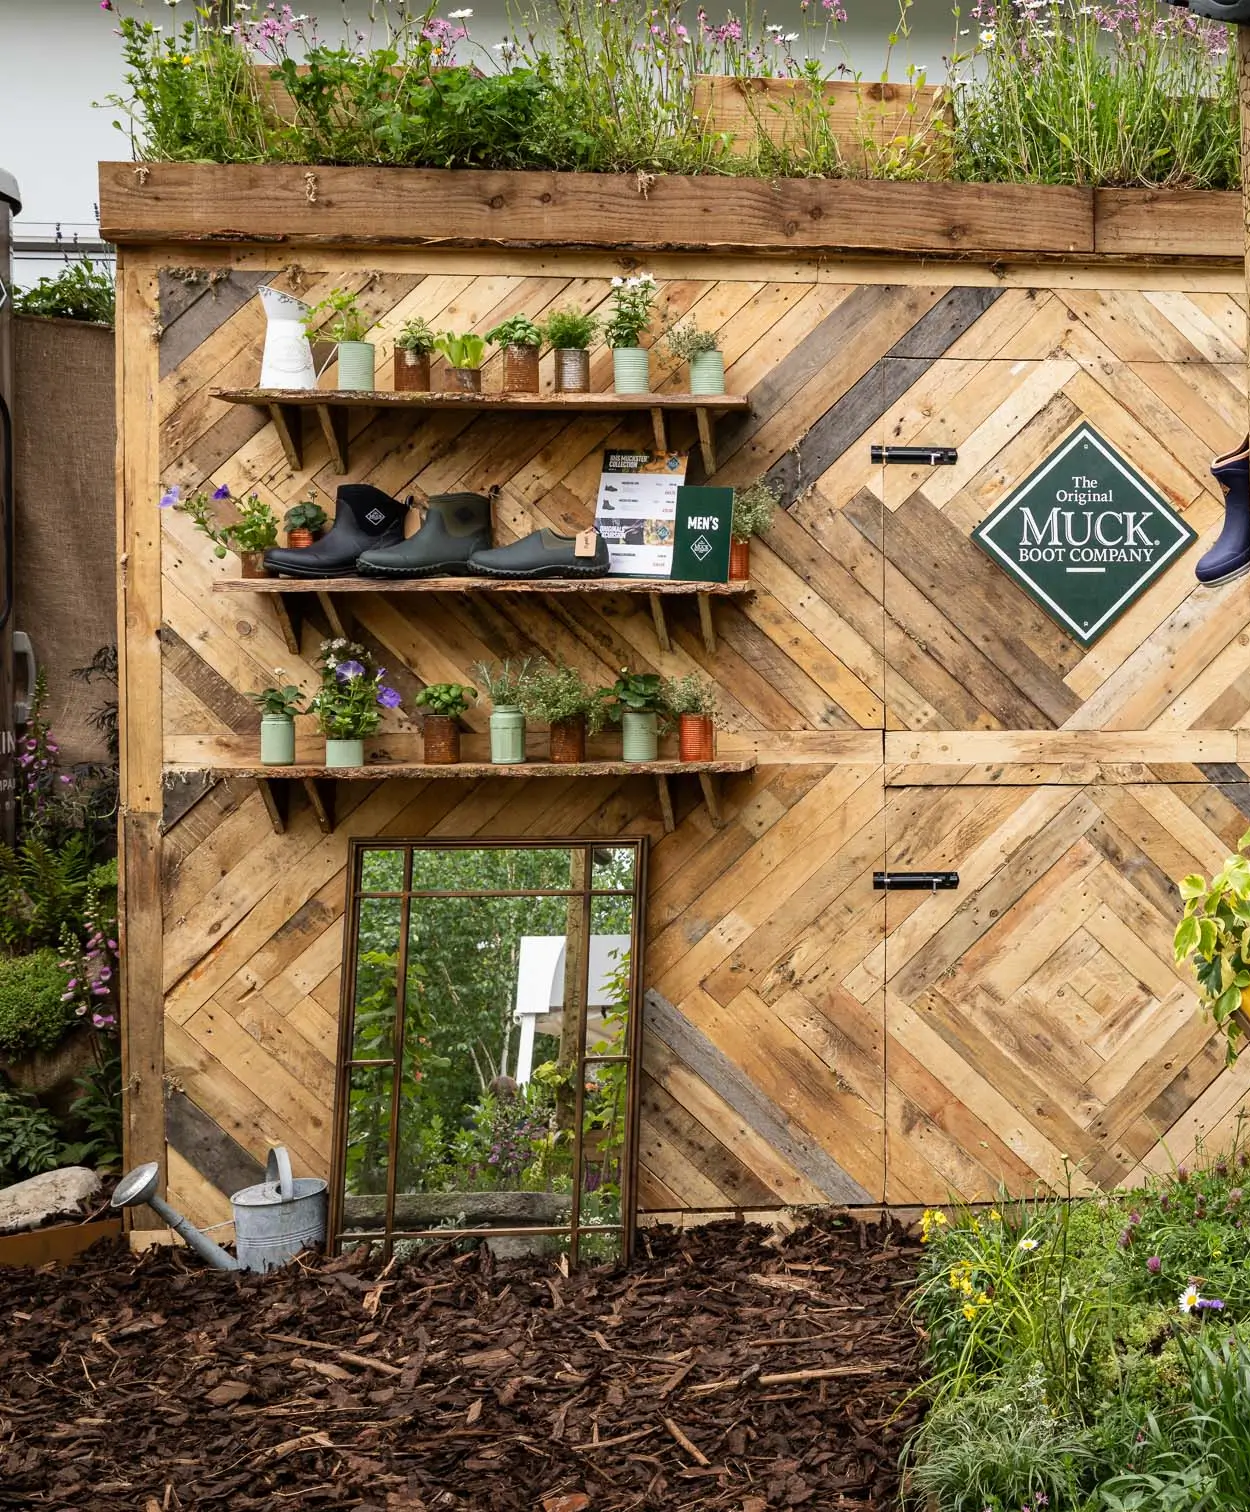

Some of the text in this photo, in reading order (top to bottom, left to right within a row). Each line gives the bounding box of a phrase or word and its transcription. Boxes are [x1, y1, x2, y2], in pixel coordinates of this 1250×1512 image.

[1071, 476, 1098, 489] The
[1056, 490, 1113, 506] Original
[687, 515, 719, 530] MEN'S
[1018, 548, 1154, 562] BOOT COMPANY
